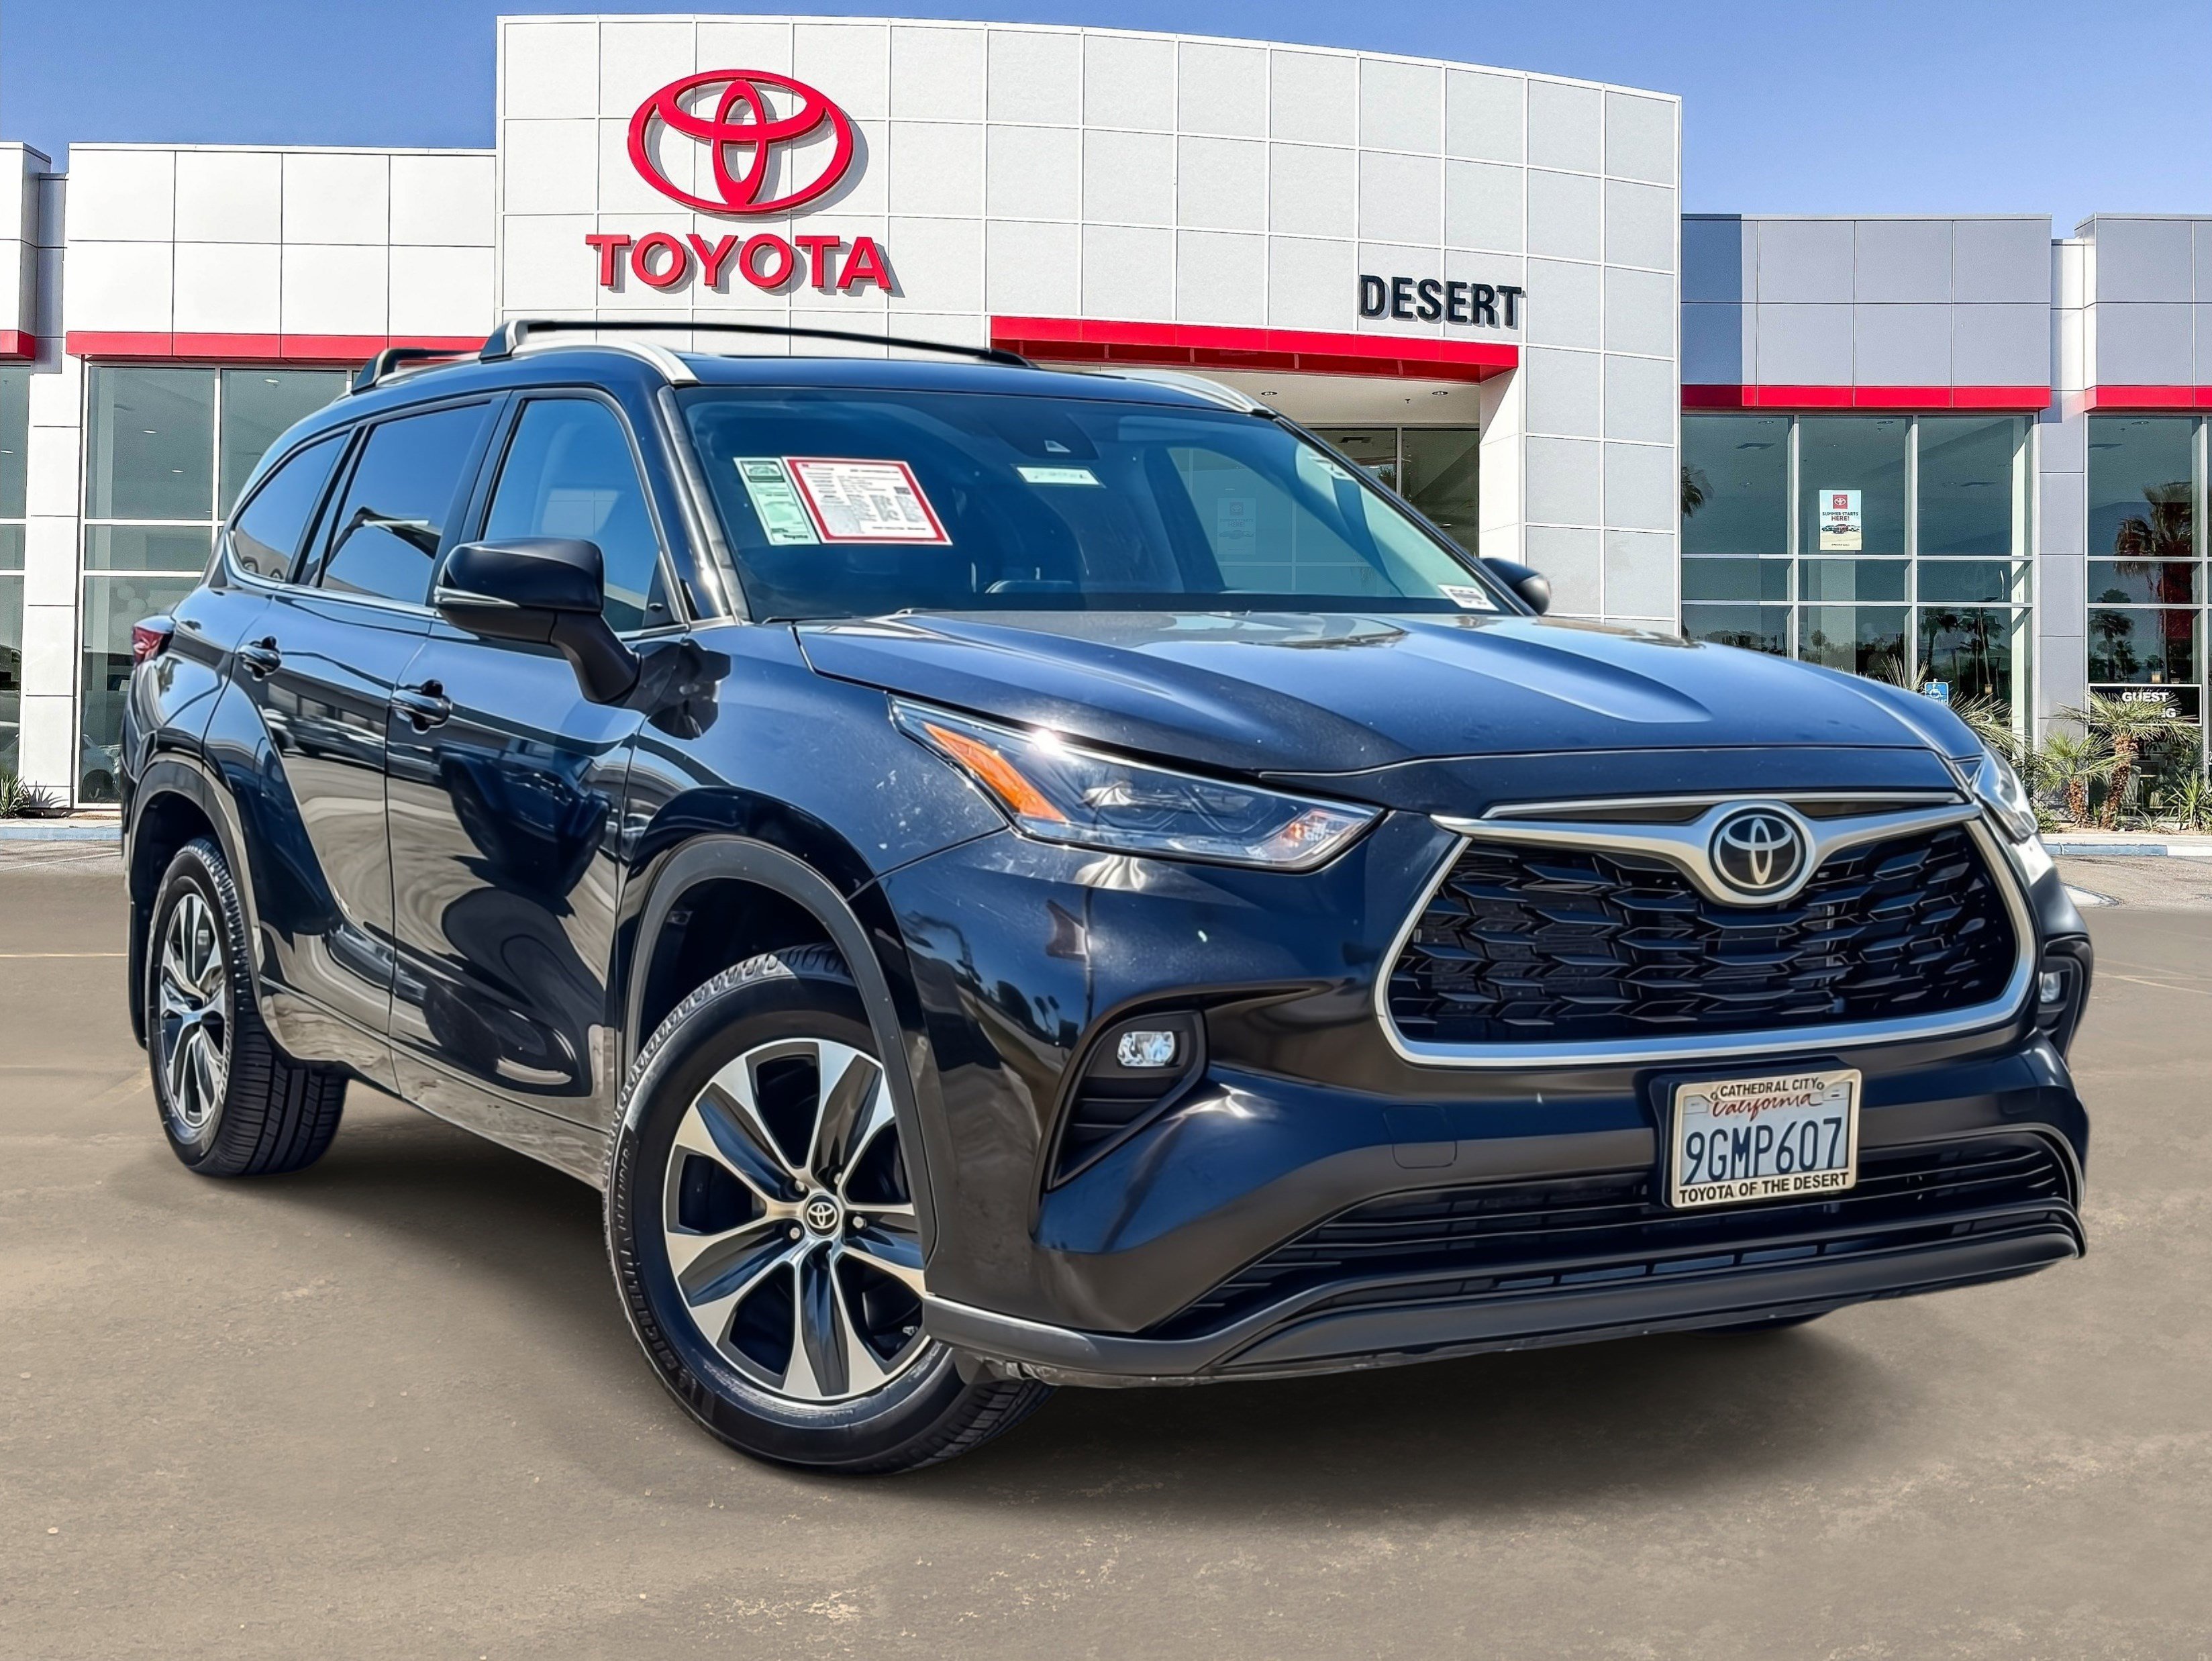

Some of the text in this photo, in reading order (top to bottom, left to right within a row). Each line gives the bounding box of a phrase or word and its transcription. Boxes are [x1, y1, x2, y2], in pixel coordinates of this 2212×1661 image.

[585, 232, 892, 290] TOYOTA
[1359, 274, 1522, 328] DESERT
[2122, 692, 2169, 703] GUEST
[1720, 1076, 1819, 1097] CATHEDRAL CITY
[1712, 1093, 1823, 1122] California
[1683, 1117, 1842, 1185] 9GMP607
[1679, 1172, 1849, 1204] TOYOTA OF THE DESERT
